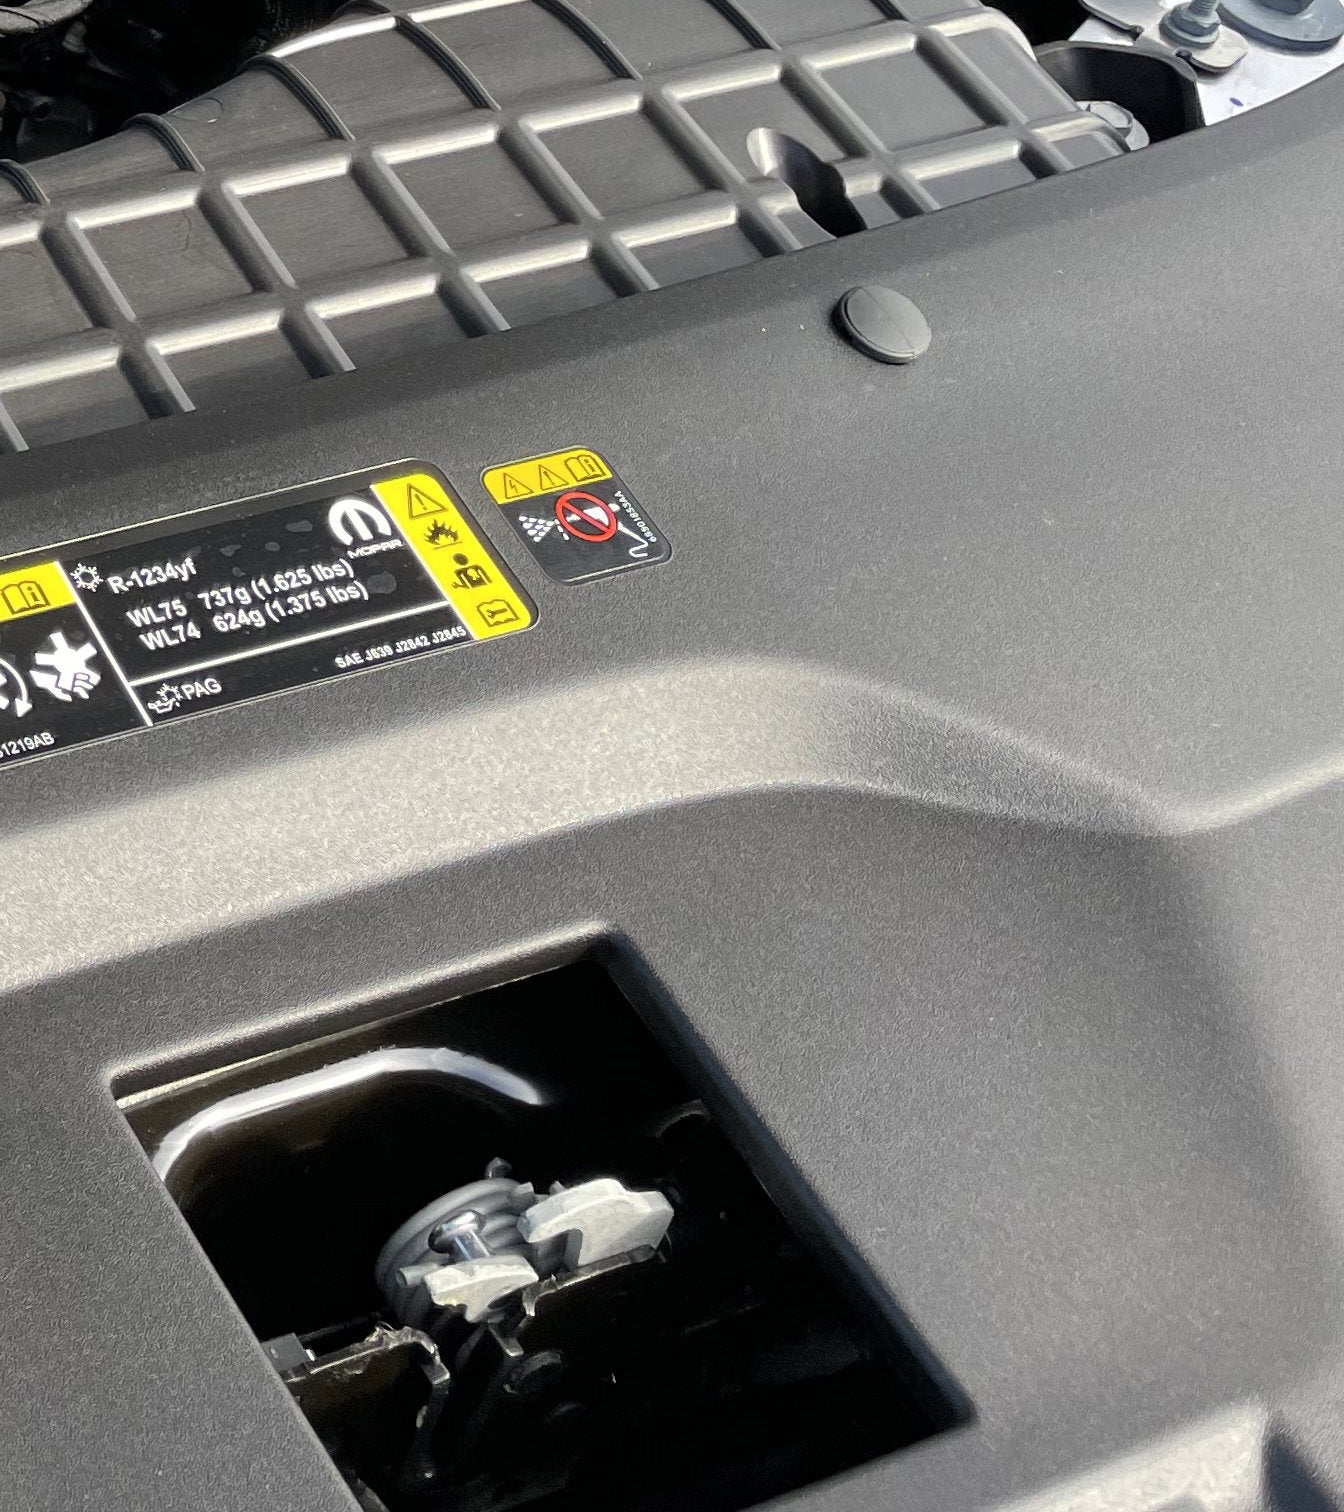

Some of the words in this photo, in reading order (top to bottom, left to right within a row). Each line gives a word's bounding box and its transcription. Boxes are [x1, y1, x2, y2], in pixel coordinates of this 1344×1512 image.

[346, 539, 404, 559] MOPAR
[107, 556, 197, 594] R-1234yf
[125, 599, 188, 628] WL75
[198, 586, 252, 610] 737g
[251, 567, 312, 601] (1.625
[312, 558, 355, 582] lbs)
[139, 621, 202, 650] WL74
[212, 607, 266, 633] 624g
[264, 590, 327, 623] (1.375
[326, 580, 369, 604] lbs)
[334, 653, 364, 668] SAE
[365, 644, 394, 661] J639
[395, 635, 431, 653] J2842
[432, 625, 467, 644] J2845
[182, 677, 222, 700] PAG
